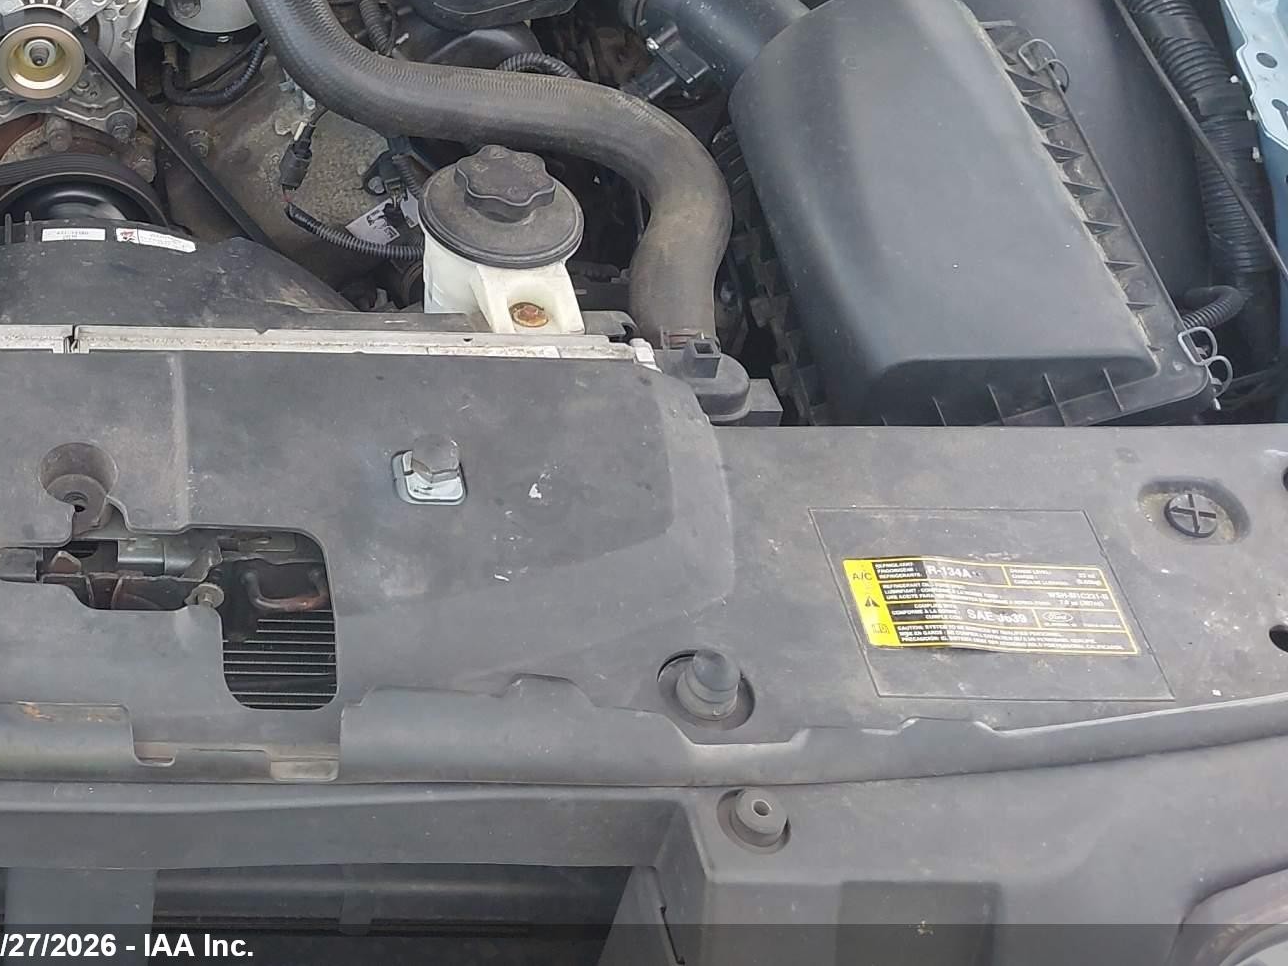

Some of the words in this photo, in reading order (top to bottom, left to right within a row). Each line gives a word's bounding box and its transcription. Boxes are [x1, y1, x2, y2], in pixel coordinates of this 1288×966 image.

[852, 571, 874, 581] A/C
[926, 564, 972, 579] R-134A
[966, 608, 995, 622] SAE
